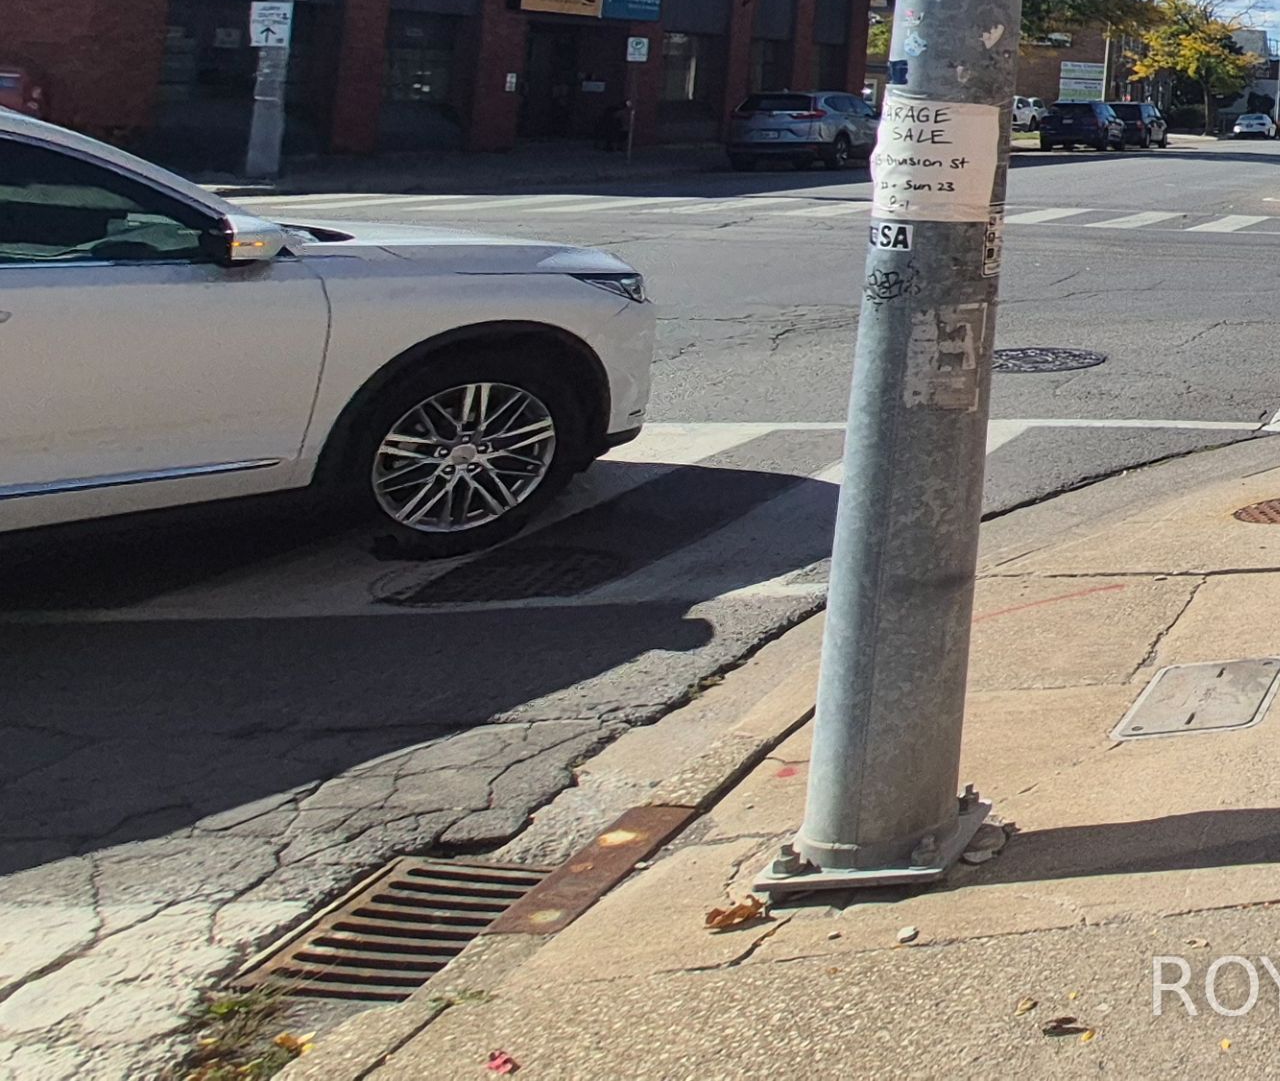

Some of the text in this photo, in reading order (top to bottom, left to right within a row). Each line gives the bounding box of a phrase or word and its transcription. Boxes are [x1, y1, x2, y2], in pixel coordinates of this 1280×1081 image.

[892, 126, 954, 145] SALE
[950, 157, 970, 169] St
[903, 179, 932, 192] Sun
[937, 181, 956, 192] 23
